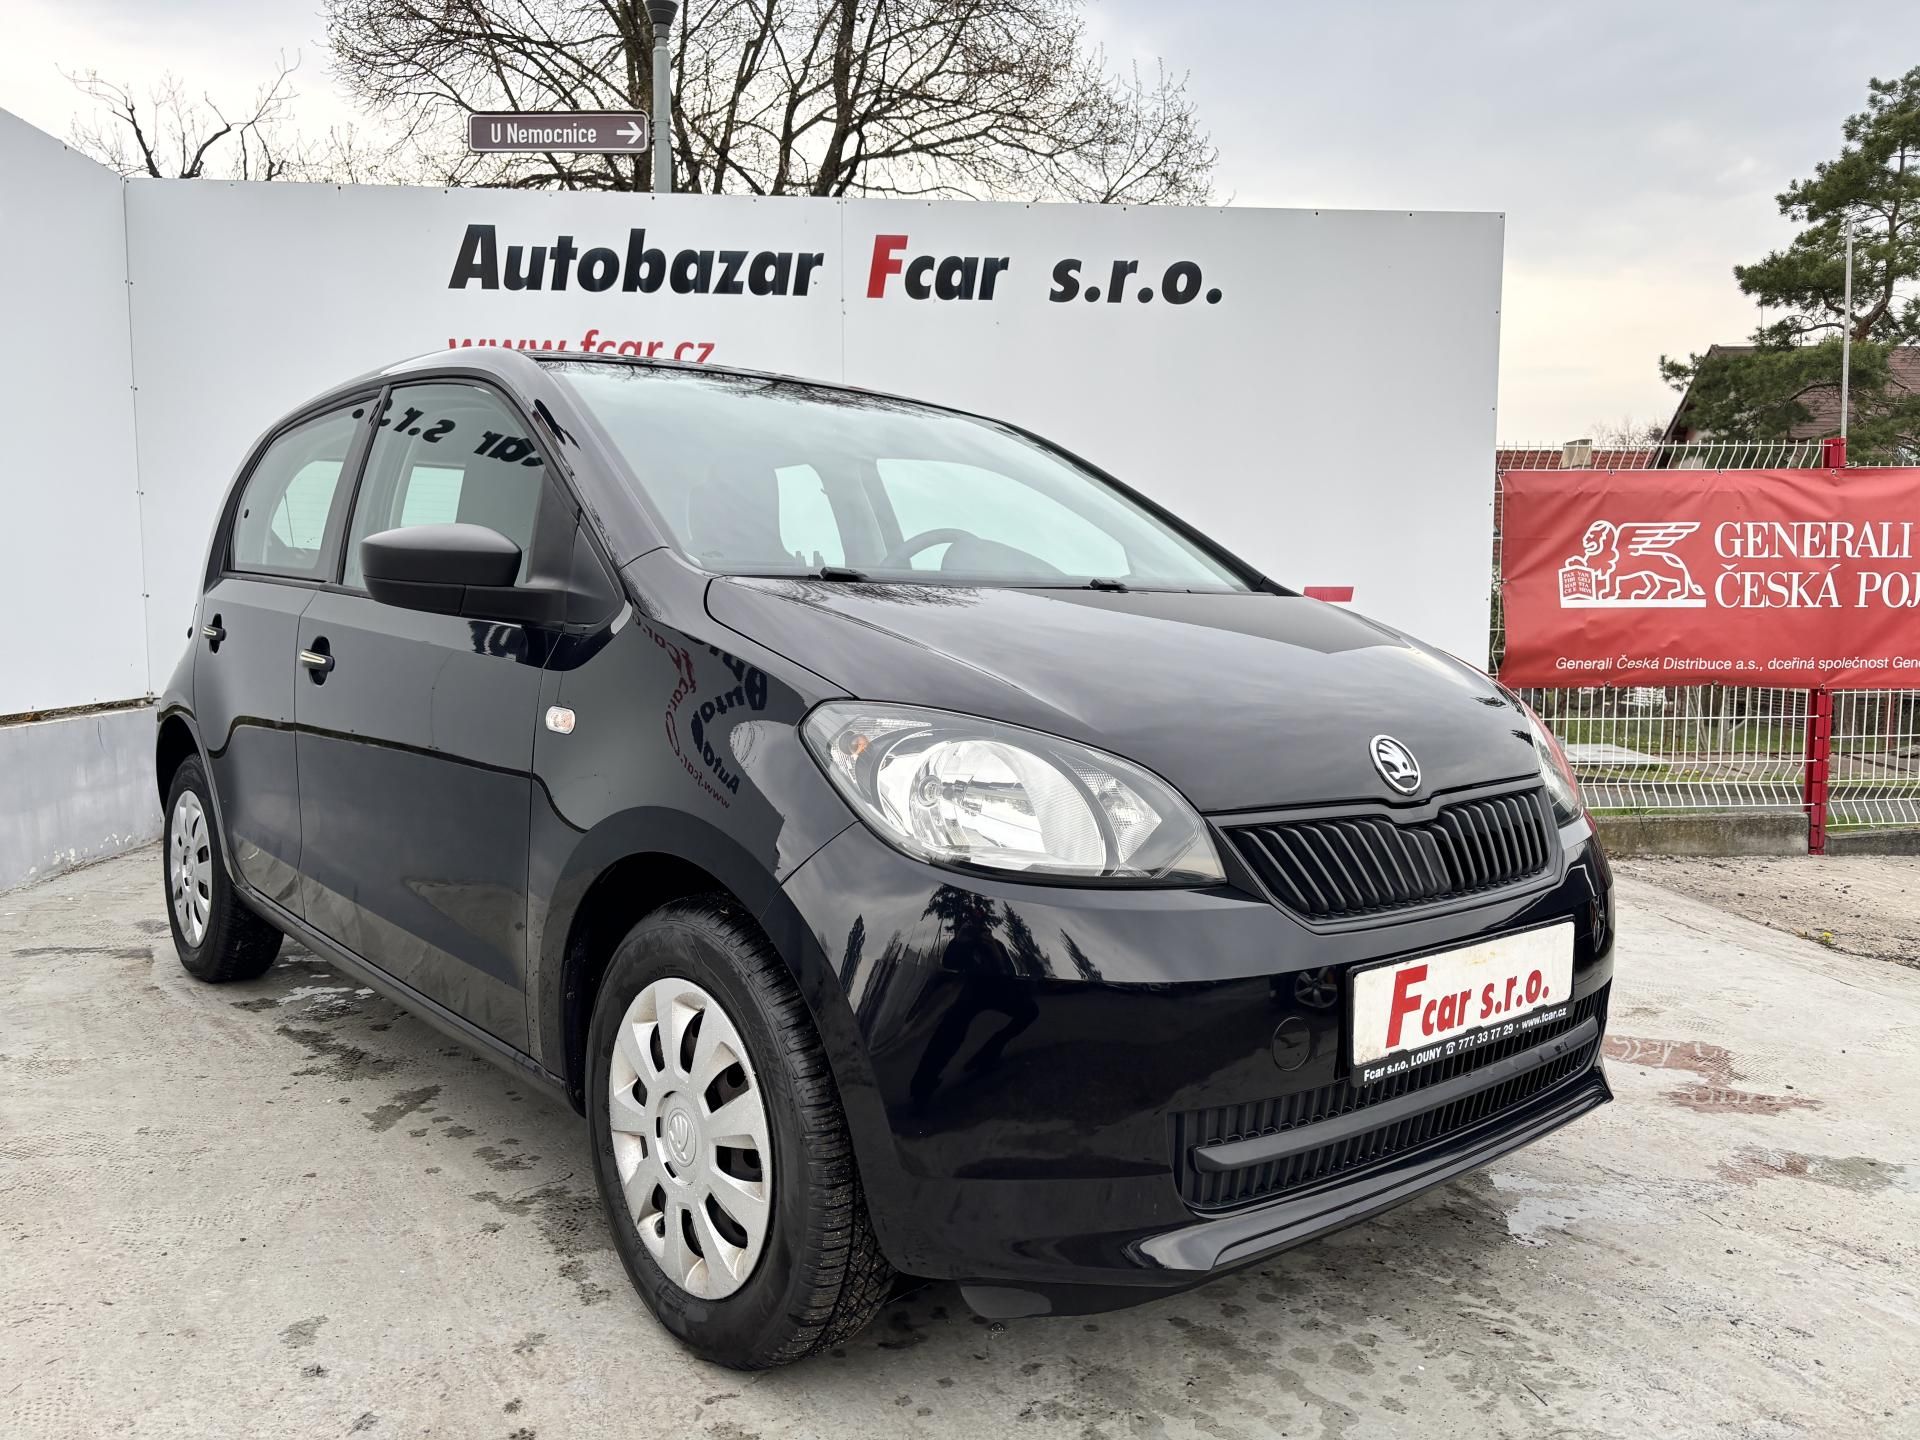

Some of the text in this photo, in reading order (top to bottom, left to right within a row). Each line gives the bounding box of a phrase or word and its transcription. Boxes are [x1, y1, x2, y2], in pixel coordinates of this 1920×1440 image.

[490, 123, 597, 144] U Nemocnice
[448, 224, 1222, 304] Autobazar Fcar s.r.o.
[1714, 521, 1914, 558] GENERALI
[1714, 563, 1920, 608] ČESKÁ POJ
[1556, 657, 1612, 671] Generali
[1616, 654, 1659, 670] Česká
[1663, 657, 1732, 670] Distribuce
[1735, 659, 1763, 672] a.s.,
[1767, 656, 1815, 670] dceřiná
[1818, 656, 1889, 672] společnost
[1386, 964, 1550, 1048] Fcar s.r.o.
[1363, 1007, 1567, 1082] Fcar s.r.o. LOUNY 777 33 77 29 www.fcar.cz
